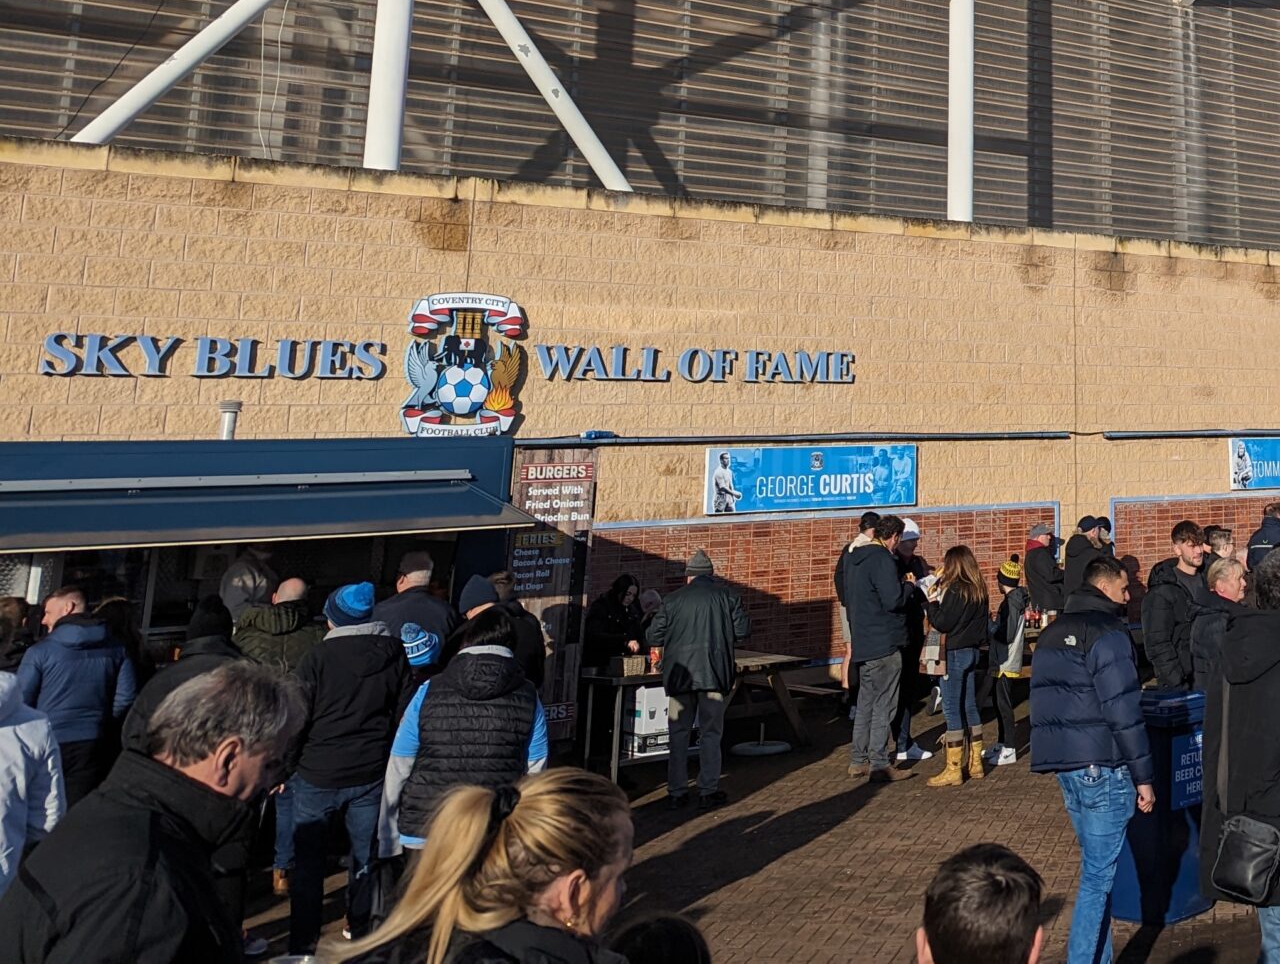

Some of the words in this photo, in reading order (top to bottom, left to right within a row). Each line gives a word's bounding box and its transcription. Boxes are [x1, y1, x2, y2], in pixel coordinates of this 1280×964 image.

[431, 296, 484, 306] COVENTRY
[485, 298, 508, 308] CITY
[41, 331, 187, 378] SKY
[190, 335, 388, 381] BLUES
[533, 343, 671, 382] WALL
[677, 347, 739, 383] OF
[743, 349, 855, 383] FAME
[420, 427, 472, 437] FOOTBALL
[527, 465, 587, 479] BURGERS
[528, 486, 559, 496] Served
[561, 485, 584, 495] With
[756, 475, 816, 497] GEORGE
[819, 473, 874, 495] CURTIS
[525, 500, 550, 509] Fried
[552, 499, 584, 508] Onions
[571, 512, 589, 521] Bun
[522, 533, 557, 545] FRIES
[514, 548, 539, 556] Cheese
[513, 559, 536, 567] Bacon
[545, 557, 570, 565] Cheese
[526, 583, 544, 591] Dogs
[1181, 750, 1202, 767] RETU
[1175, 767, 1194, 782] BEER
